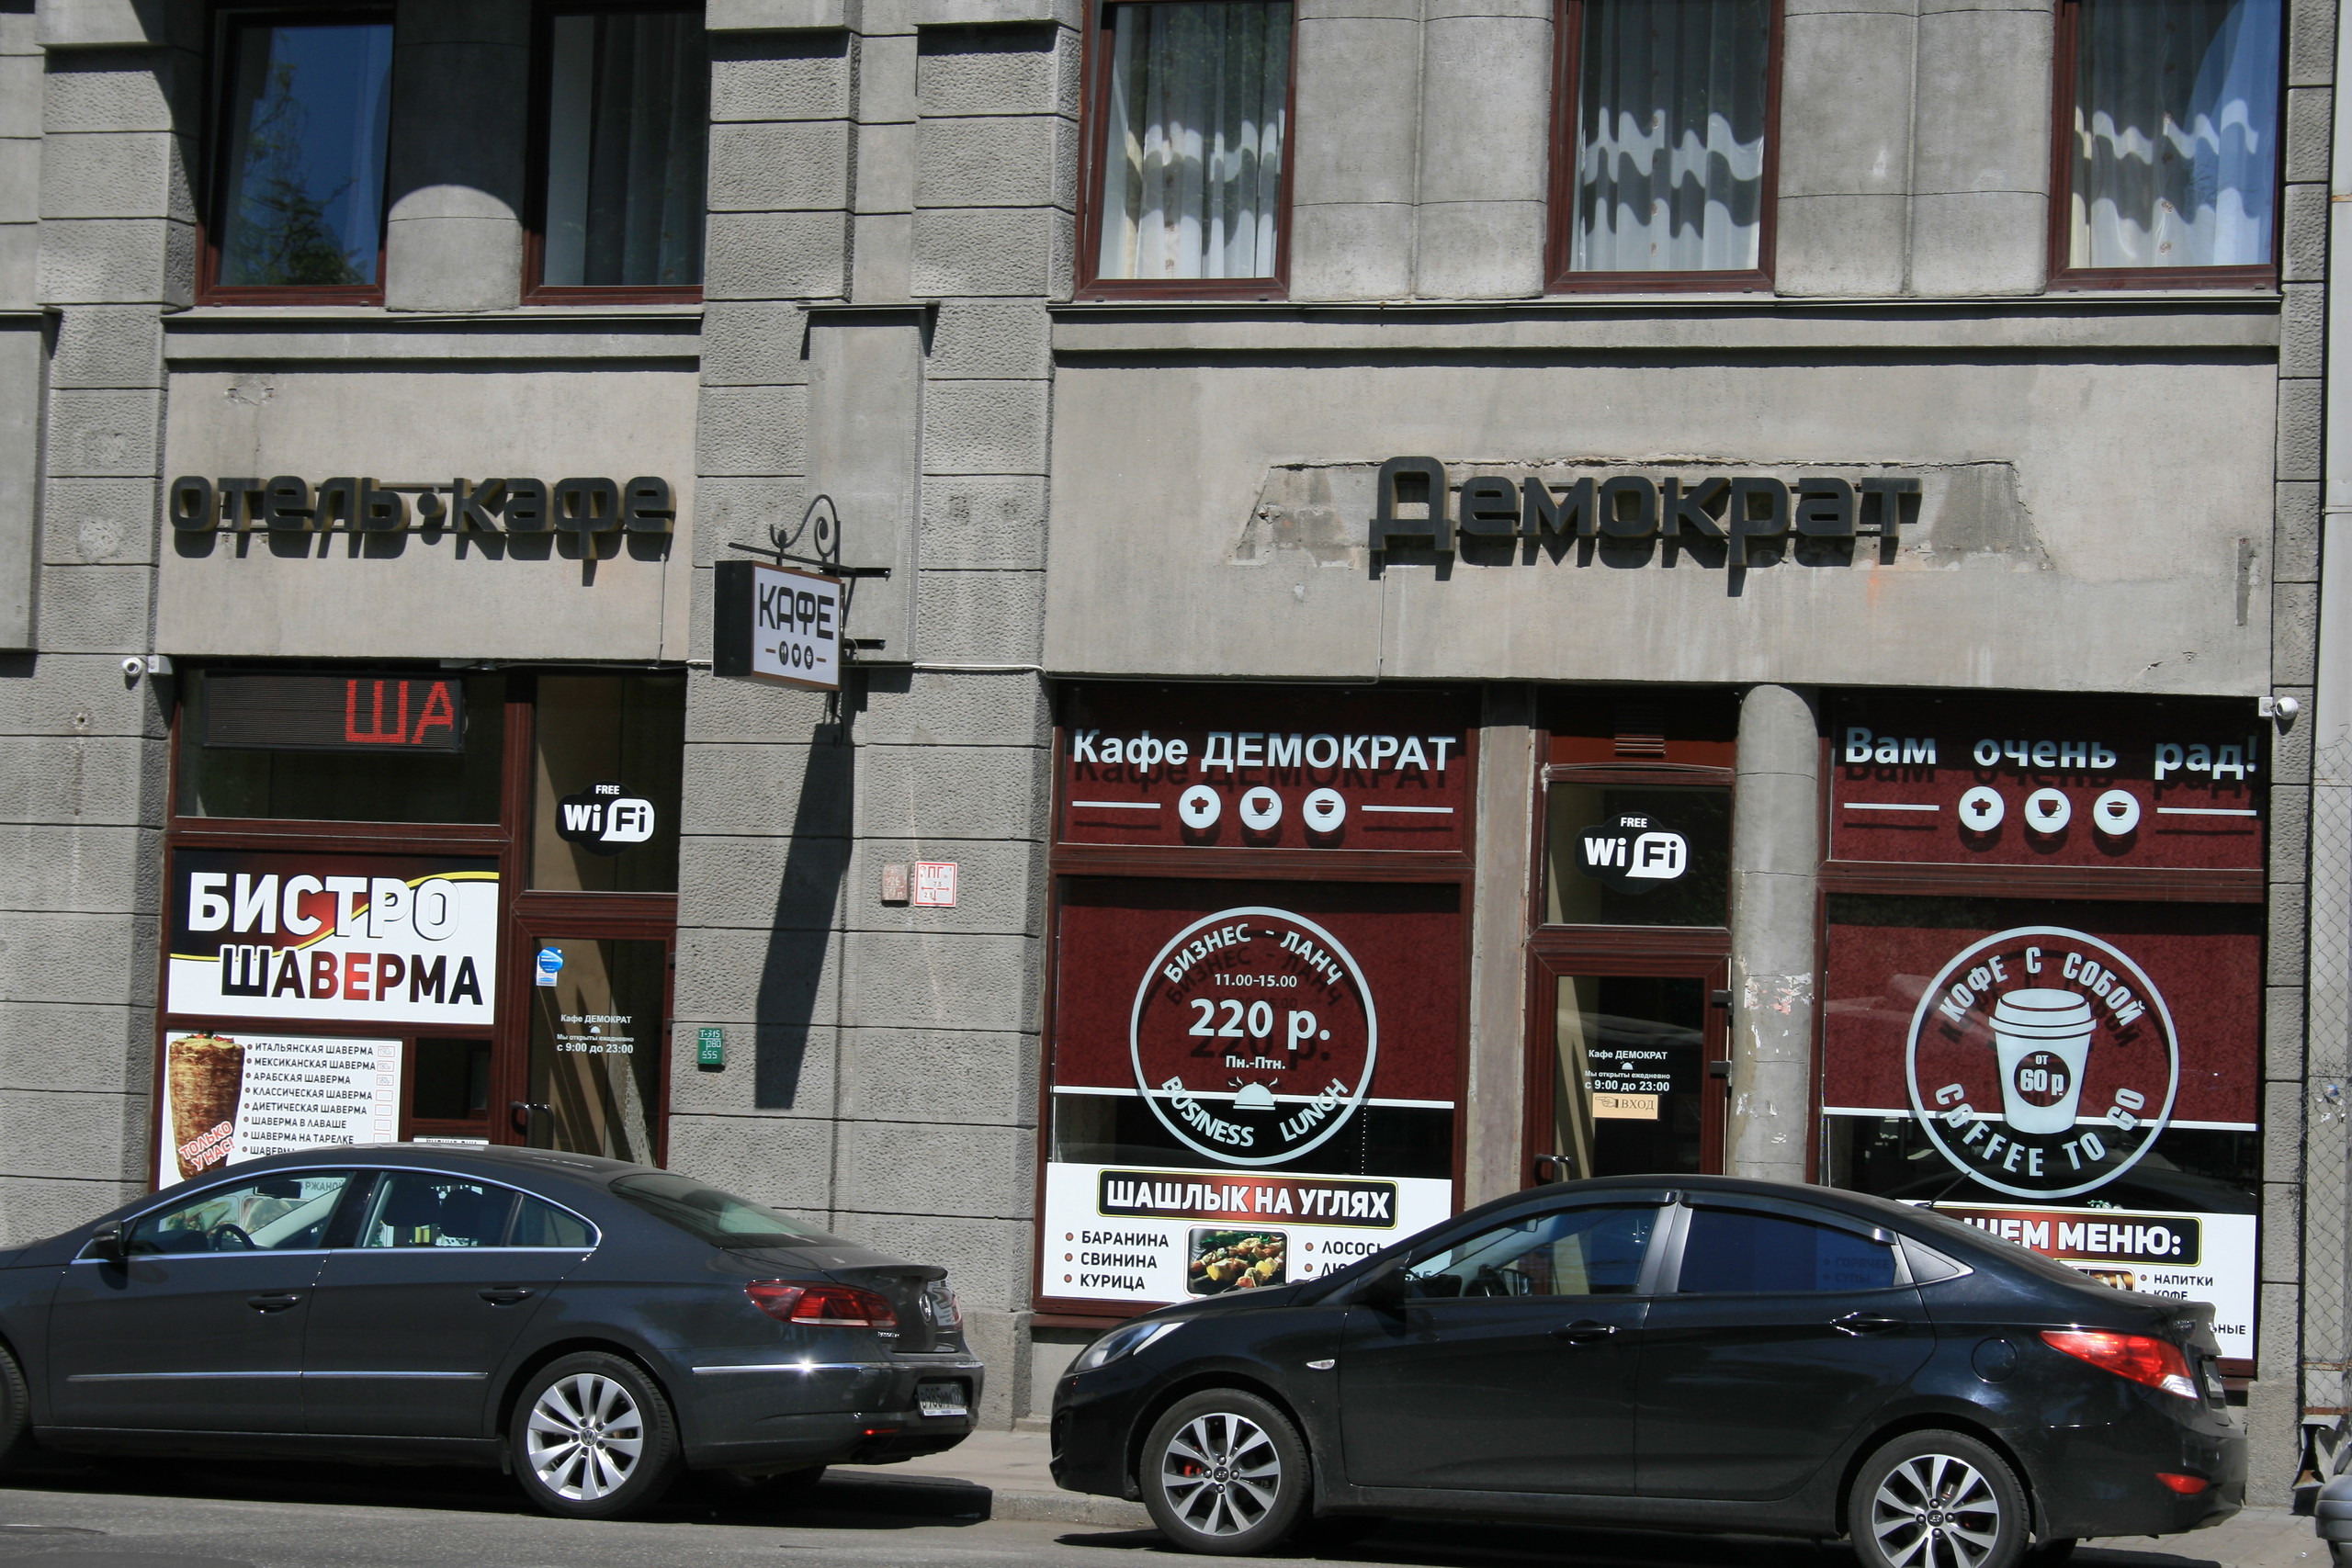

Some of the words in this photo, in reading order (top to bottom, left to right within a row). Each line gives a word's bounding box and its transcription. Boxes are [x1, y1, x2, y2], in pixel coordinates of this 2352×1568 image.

[1369, 456, 1923, 566] Демократ
[759, 582, 834, 640] КАФЕ
[345, 680, 454, 744] ША
[1073, 728, 1188, 773] Кафе
[1201, 731, 1456, 773] ДЕМОКРАТ
[1845, 727, 1937, 764] Вам
[1973, 736, 2117, 769] очень
[2154, 736, 2257, 781] рад!
[595, 784, 620, 795] FREE
[1620, 817, 1647, 828] FREE
[188, 872, 460, 941] БИСТРО
[1163, 923, 1251, 984] БИЗНЕС
[1280, 931, 1343, 986] ЛАНЧ
[220, 945, 484, 1005] ШАВЕРМА
[1215, 974, 1297, 987] 11.00-15.00
[1939, 954, 2008, 1022] КОФЕ
[2026, 947, 2042, 974] С
[2063, 953, 2146, 1026] СОБОЙ
[560, 1014, 582, 1023] Кафе
[584, 1015, 632, 1024] ДЕМОКРАТ
[1189, 998, 1274, 1038] 220
[1288, 1010, 1330, 1050] р.
[255, 1043, 323, 1054] ИТАЛЬЯНСКАЯ
[326, 1044, 374, 1055] ШАВЕРМА
[565, 1043, 587, 1052] 9:00
[589, 1045, 604, 1054] до
[606, 1043, 634, 1054] 23:00
[1589, 1050, 1613, 1060] Кафе
[1614, 1050, 1668, 1060] ДЕМОКРАТ
[254, 1058, 328, 1069] МЕКСИКАНСКАЯ
[329, 1059, 376, 1070] ШАВЕРМА
[1226, 1055, 1286, 1069] Пн.-Птн.
[254, 1073, 302, 1083] АРАБСКАЯ
[304, 1074, 351, 1084] ШАВЕРМА
[1585, 1081, 1592, 1089] с
[1594, 1079, 1618, 1090] 9:00
[1621, 1082, 1636, 1091] до
[1639, 1081, 1669, 1091] 23:00
[2020, 1068, 2048, 1092] 60
[253, 1087, 324, 1099] КЛАССИЧЕСКАЯ
[325, 1089, 372, 1100] ШАВЕРМА
[252, 1102, 319, 1113] ДИЕТИЧЕСКАЯ
[321, 1104, 368, 1115] ШАВЕРМА
[1161, 1076, 1254, 1146] BUSINESS
[1279, 1077, 1349, 1142] LUNCH
[1621, 1100, 1655, 1111] ВХОД
[252, 1116, 298, 1127] ШАВЕРМА
[300, 1119, 305, 1127] В
[307, 1119, 346, 1129] ЛАВАШЕ
[1935, 1083, 2043, 1177] COFFEE
[2062, 1132, 2106, 1170] TO
[2106, 1088, 2145, 1132] GO
[179, 1122, 232, 1159] ТОЛЬКО
[251, 1132, 297, 1142] ШАВЕРМА
[299, 1134, 311, 1143] НА
[313, 1134, 354, 1145] ТАРЕЛКЕ
[192, 1155, 203, 1170] У
[203, 1136, 235, 1165] НАС!
[1106, 1179, 1250, 1214] ШАШЛЫК
[1254, 1187, 1295, 1215] НА
[1297, 1188, 1390, 1219] УГЛЯХ
[1081, 1230, 1170, 1248] БАРАНИНА
[2057, 1221, 2182, 1257] МЕНЮ:
[1080, 1252, 1158, 1269] СВИНИНА
[1835, 1258, 1891, 1269] ГОРЯЧЕЕ
[1080, 1273, 1146, 1291] КУРИЦА
[2154, 1274, 2213, 1286] НАПИТКИ
